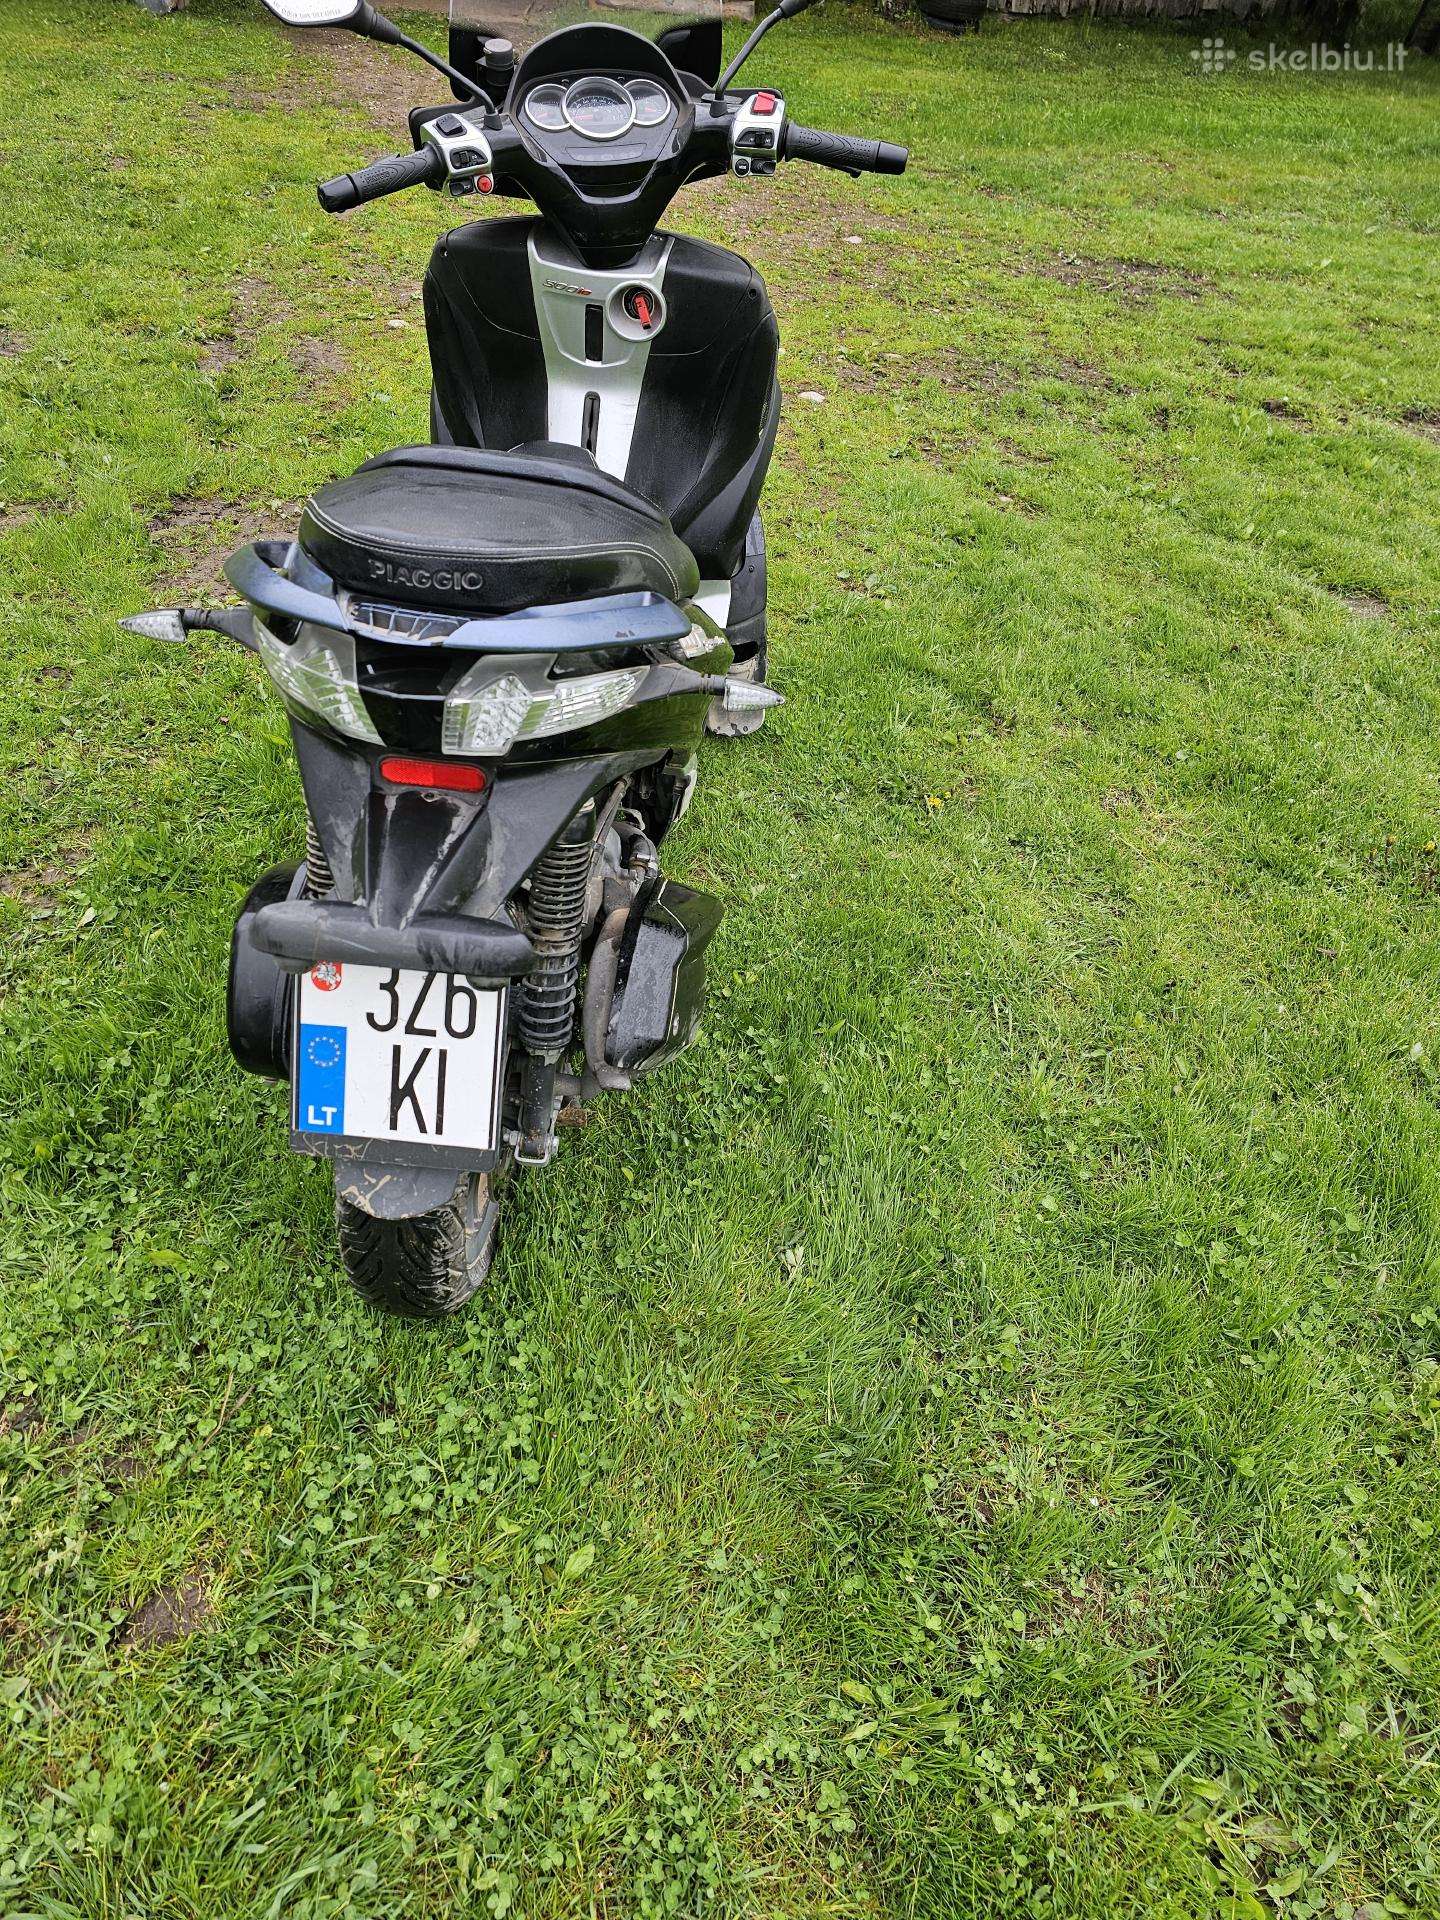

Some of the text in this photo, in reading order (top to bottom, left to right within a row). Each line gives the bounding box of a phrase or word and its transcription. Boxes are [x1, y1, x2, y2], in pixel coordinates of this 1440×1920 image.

[368, 558, 484, 591] PIAGGIO
[389, 1043, 448, 1136] KI
[307, 1104, 338, 1126] LT
